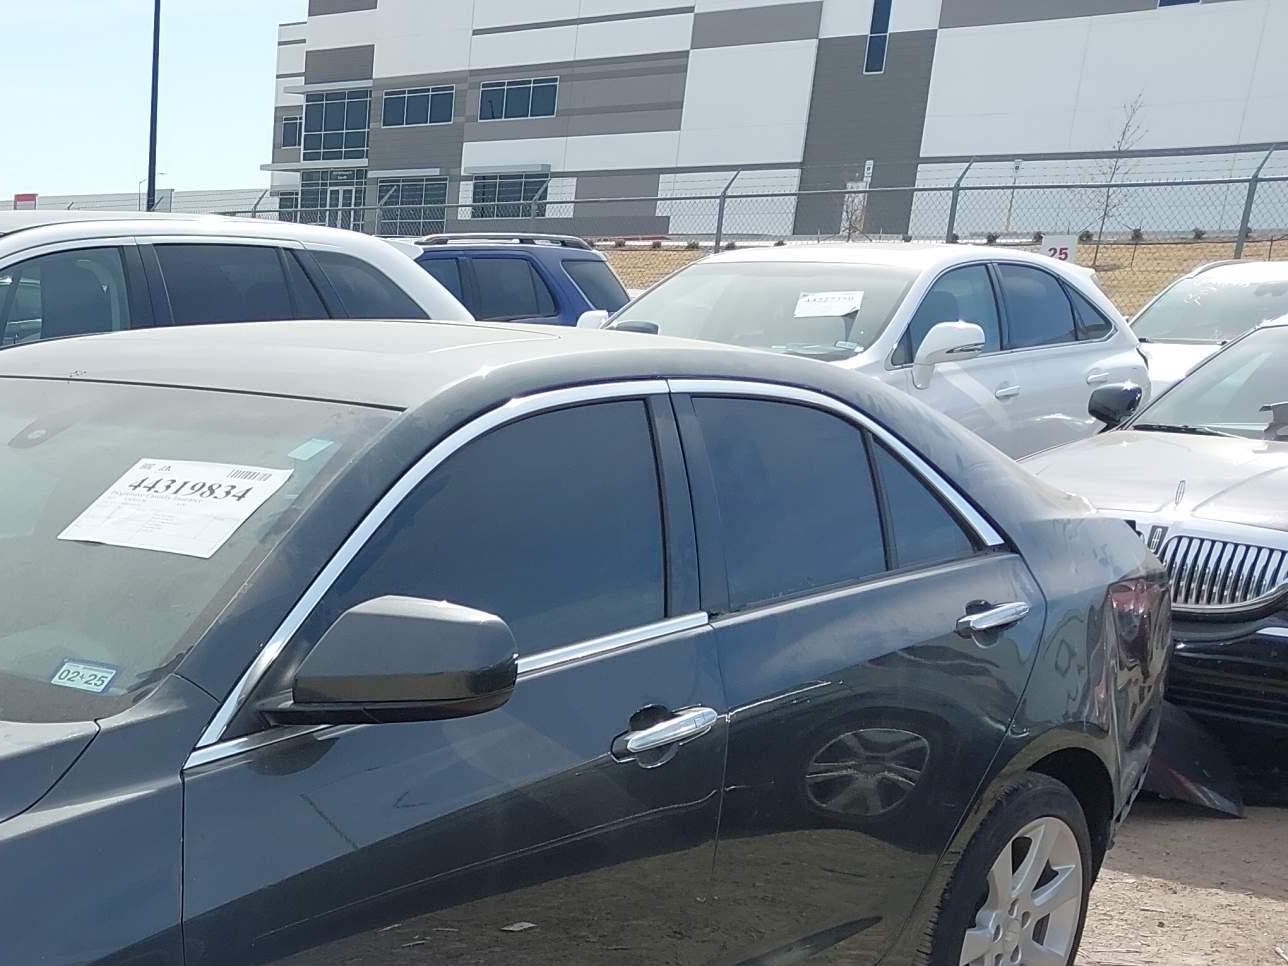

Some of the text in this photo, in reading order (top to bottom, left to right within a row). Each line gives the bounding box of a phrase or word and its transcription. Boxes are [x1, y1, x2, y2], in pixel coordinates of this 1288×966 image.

[1047, 247, 1069, 261] 25
[128, 476, 254, 502] 44319834
[58, 669, 108, 687] 02 25
